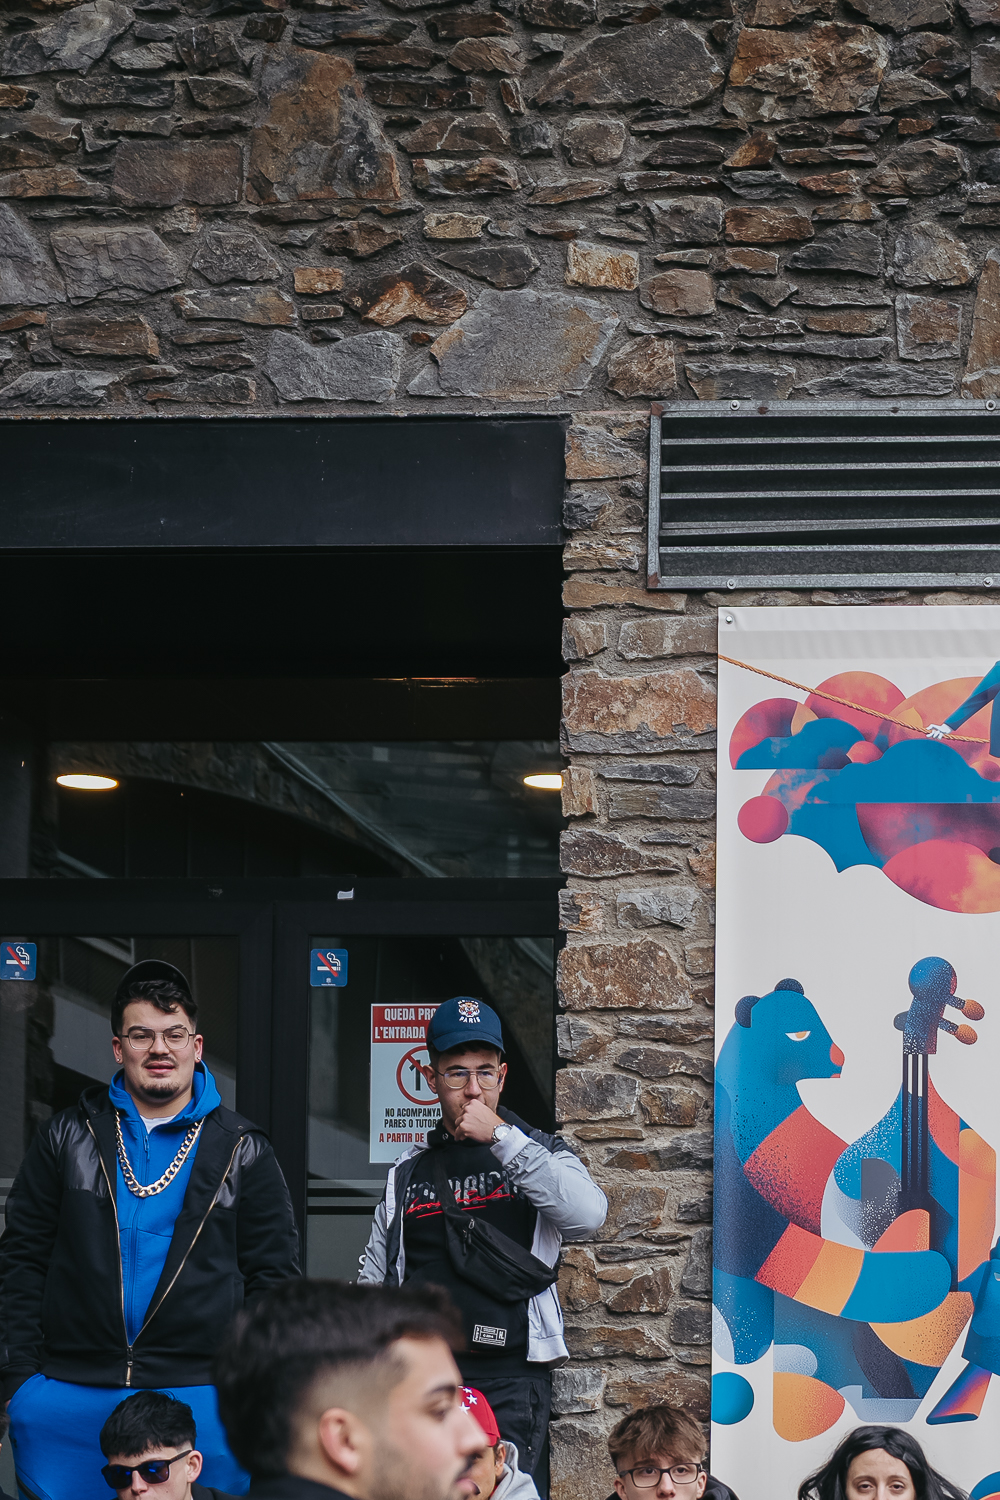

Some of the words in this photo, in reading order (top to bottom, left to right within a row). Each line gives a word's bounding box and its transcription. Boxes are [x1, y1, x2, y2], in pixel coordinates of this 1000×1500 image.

[384, 1008, 416, 1021] QUEDA
[458, 1015, 481, 1024] PARIS
[374, 1026, 426, 1039] L'ENTRADA
[385, 1108, 395, 1117] NO
[397, 1108, 441, 1117] ACOMPANYA
[384, 1119, 407, 1128] PARES
[408, 1119, 414, 1128] O
[415, 1119, 439, 1128] TUTOR
[379, 1133, 385, 1142] A
[386, 1133, 413, 1142] PARTIR
[415, 1133, 424, 1142] DE
